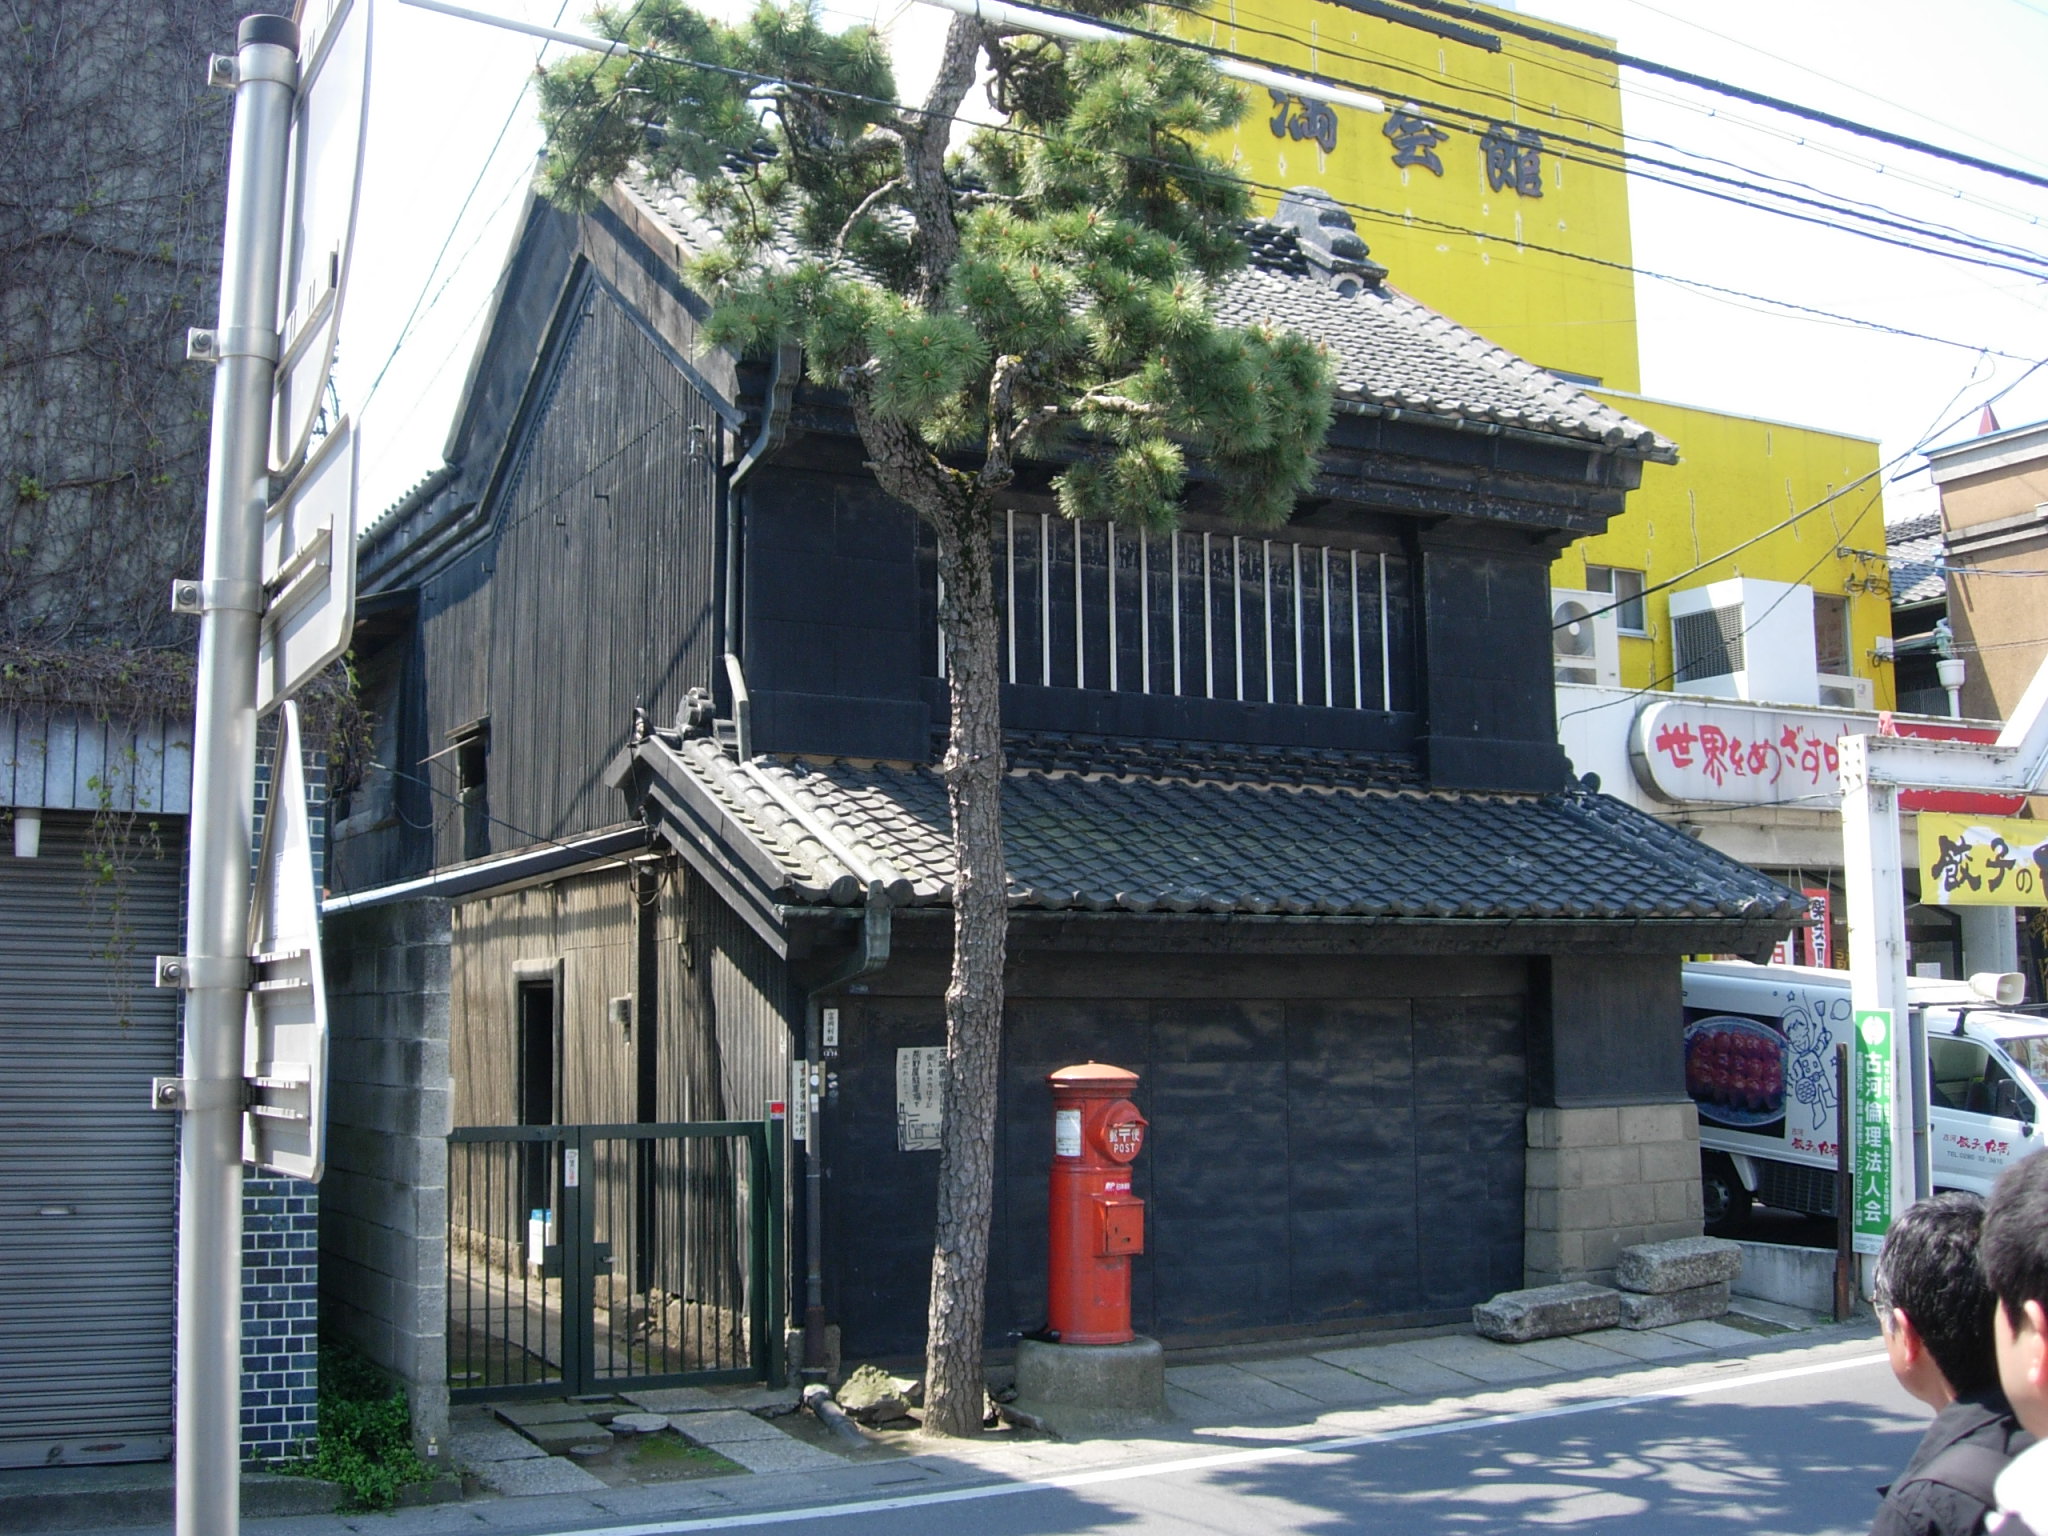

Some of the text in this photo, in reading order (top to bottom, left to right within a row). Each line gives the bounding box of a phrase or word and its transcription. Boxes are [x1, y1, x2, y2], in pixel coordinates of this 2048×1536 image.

[1931, 835, 2048, 899] 餃子の
[1113, 1143, 1136, 1153] POST
[1863, 1051, 1884, 1223] 古河倫理法人会
